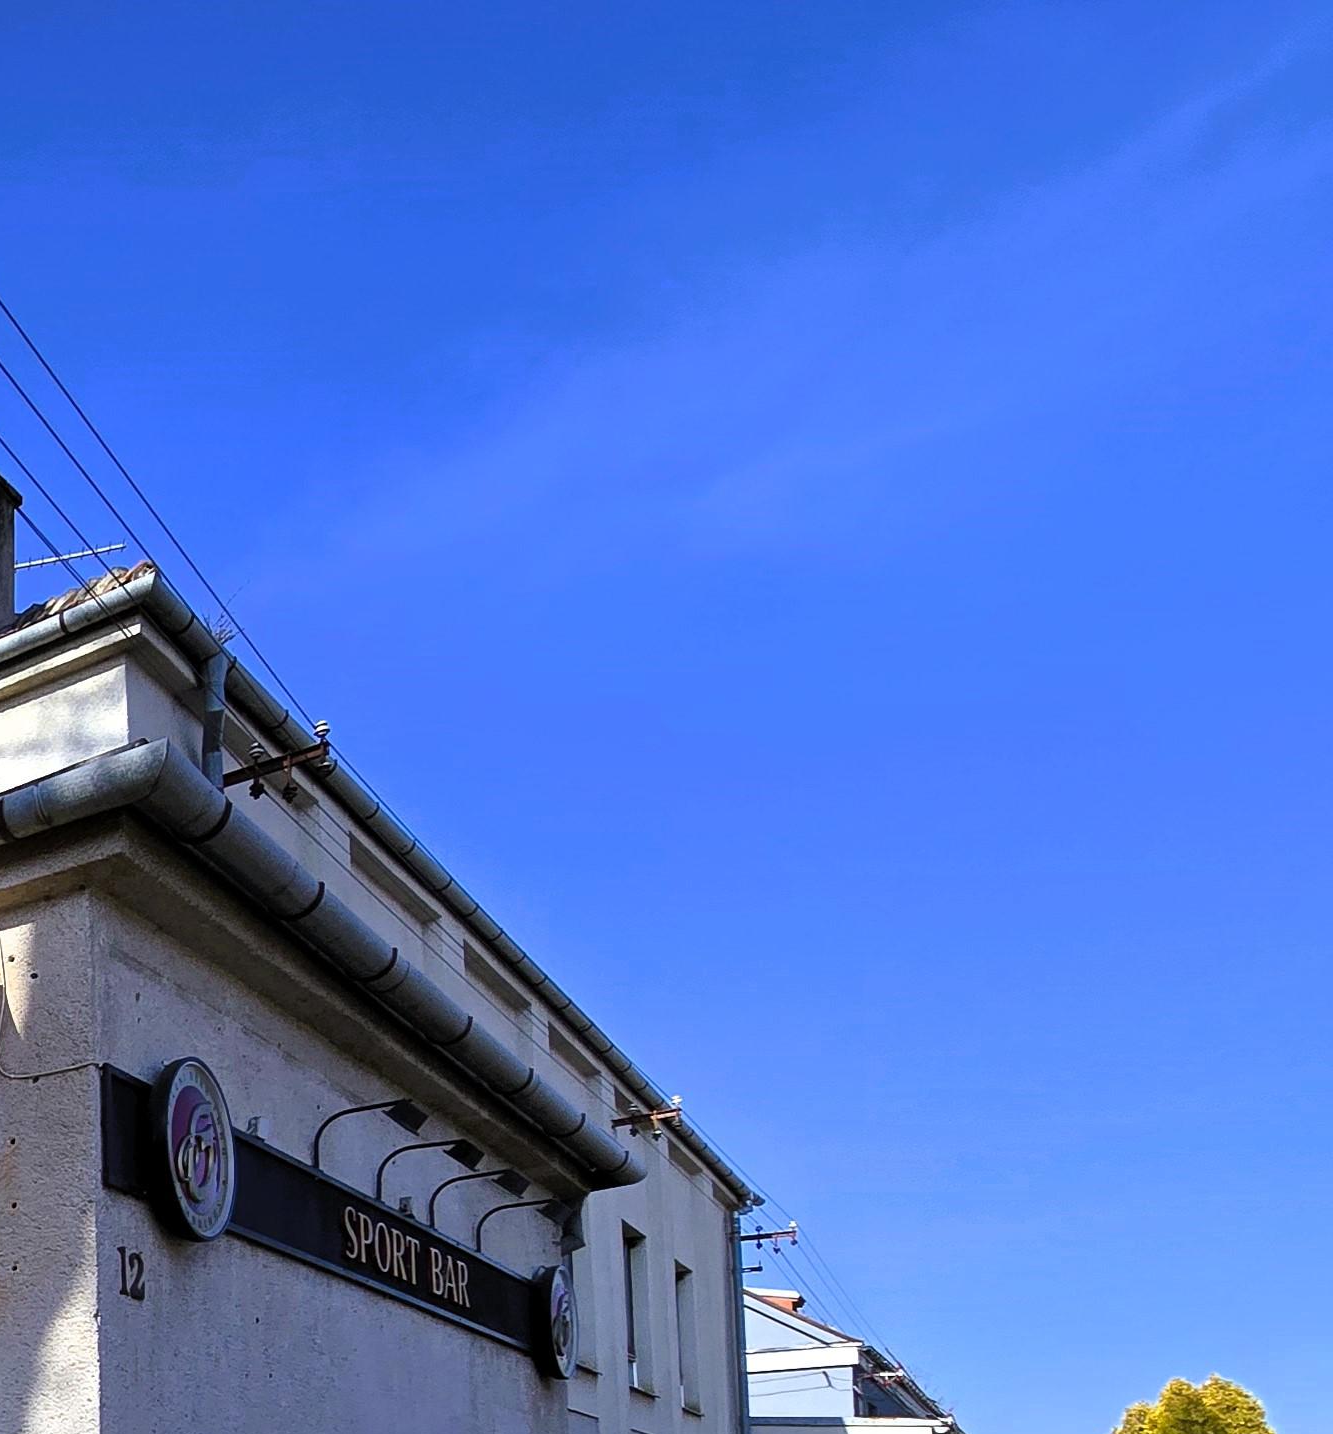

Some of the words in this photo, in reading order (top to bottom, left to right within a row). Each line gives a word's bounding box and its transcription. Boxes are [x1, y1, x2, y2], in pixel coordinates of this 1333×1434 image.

[117, 1246, 145, 1300] 12
[344, 1206, 420, 1285] SPORT
[429, 1247, 470, 1308] BAR
